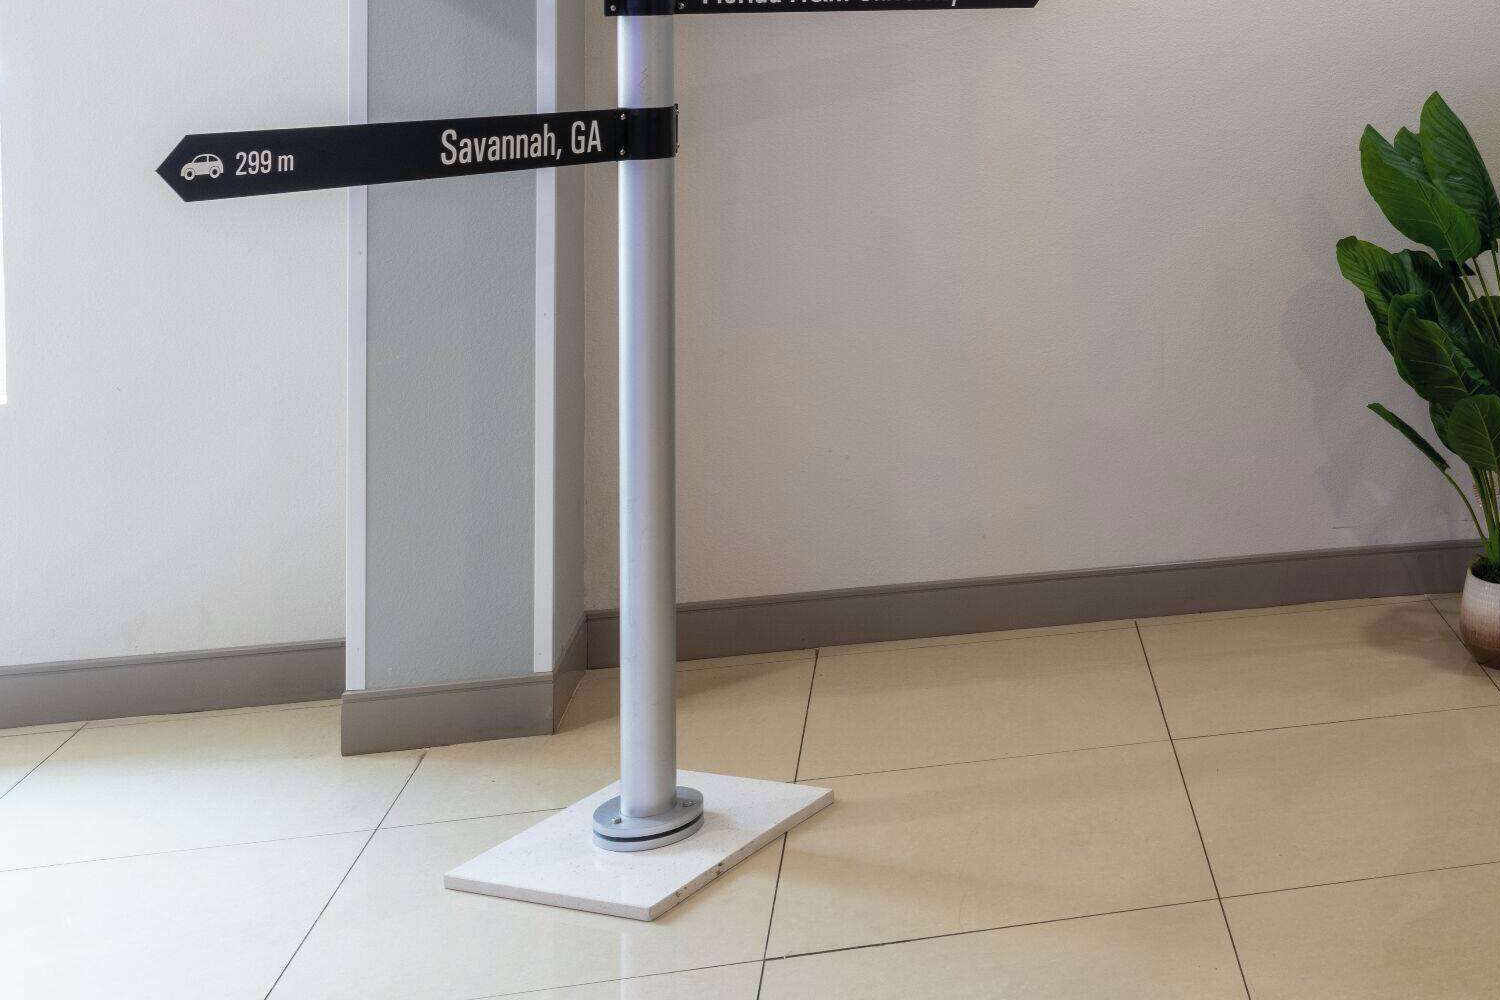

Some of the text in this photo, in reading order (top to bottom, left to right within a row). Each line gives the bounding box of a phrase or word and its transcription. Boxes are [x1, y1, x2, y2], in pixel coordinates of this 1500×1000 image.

[235, 120, 602, 176] 299 m Savannah, GA
